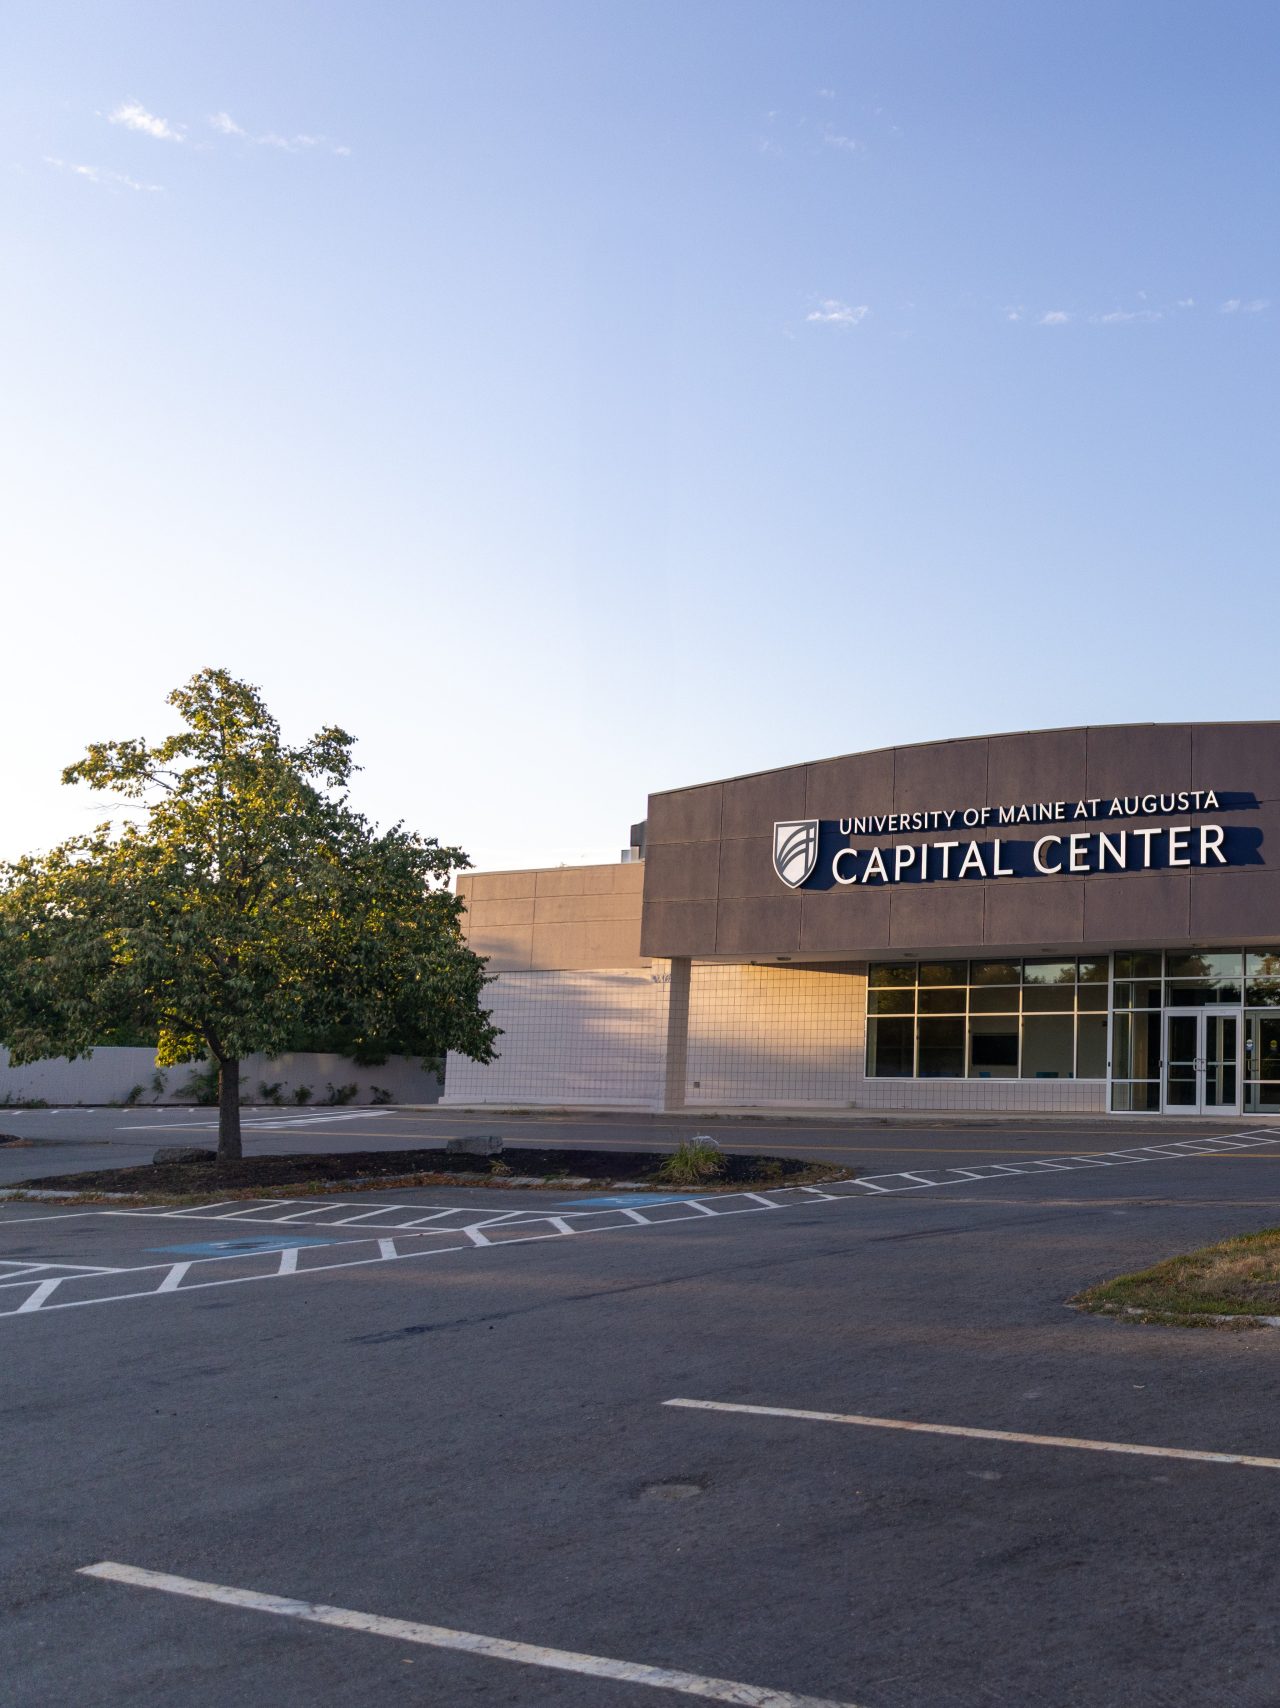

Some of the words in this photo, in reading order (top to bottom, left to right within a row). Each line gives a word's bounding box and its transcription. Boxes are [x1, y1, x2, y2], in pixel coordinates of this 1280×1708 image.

[839, 809, 956, 835] UNIVERSITY
[963, 806, 991, 826] OF
[999, 801, 1065, 824] MAINE
[1073, 798, 1101, 819] AT
[1108, 789, 1220, 816] AUGUSTA
[832, 838, 1014, 885] CAPITAL
[1033, 824, 1228, 874] CENTER
